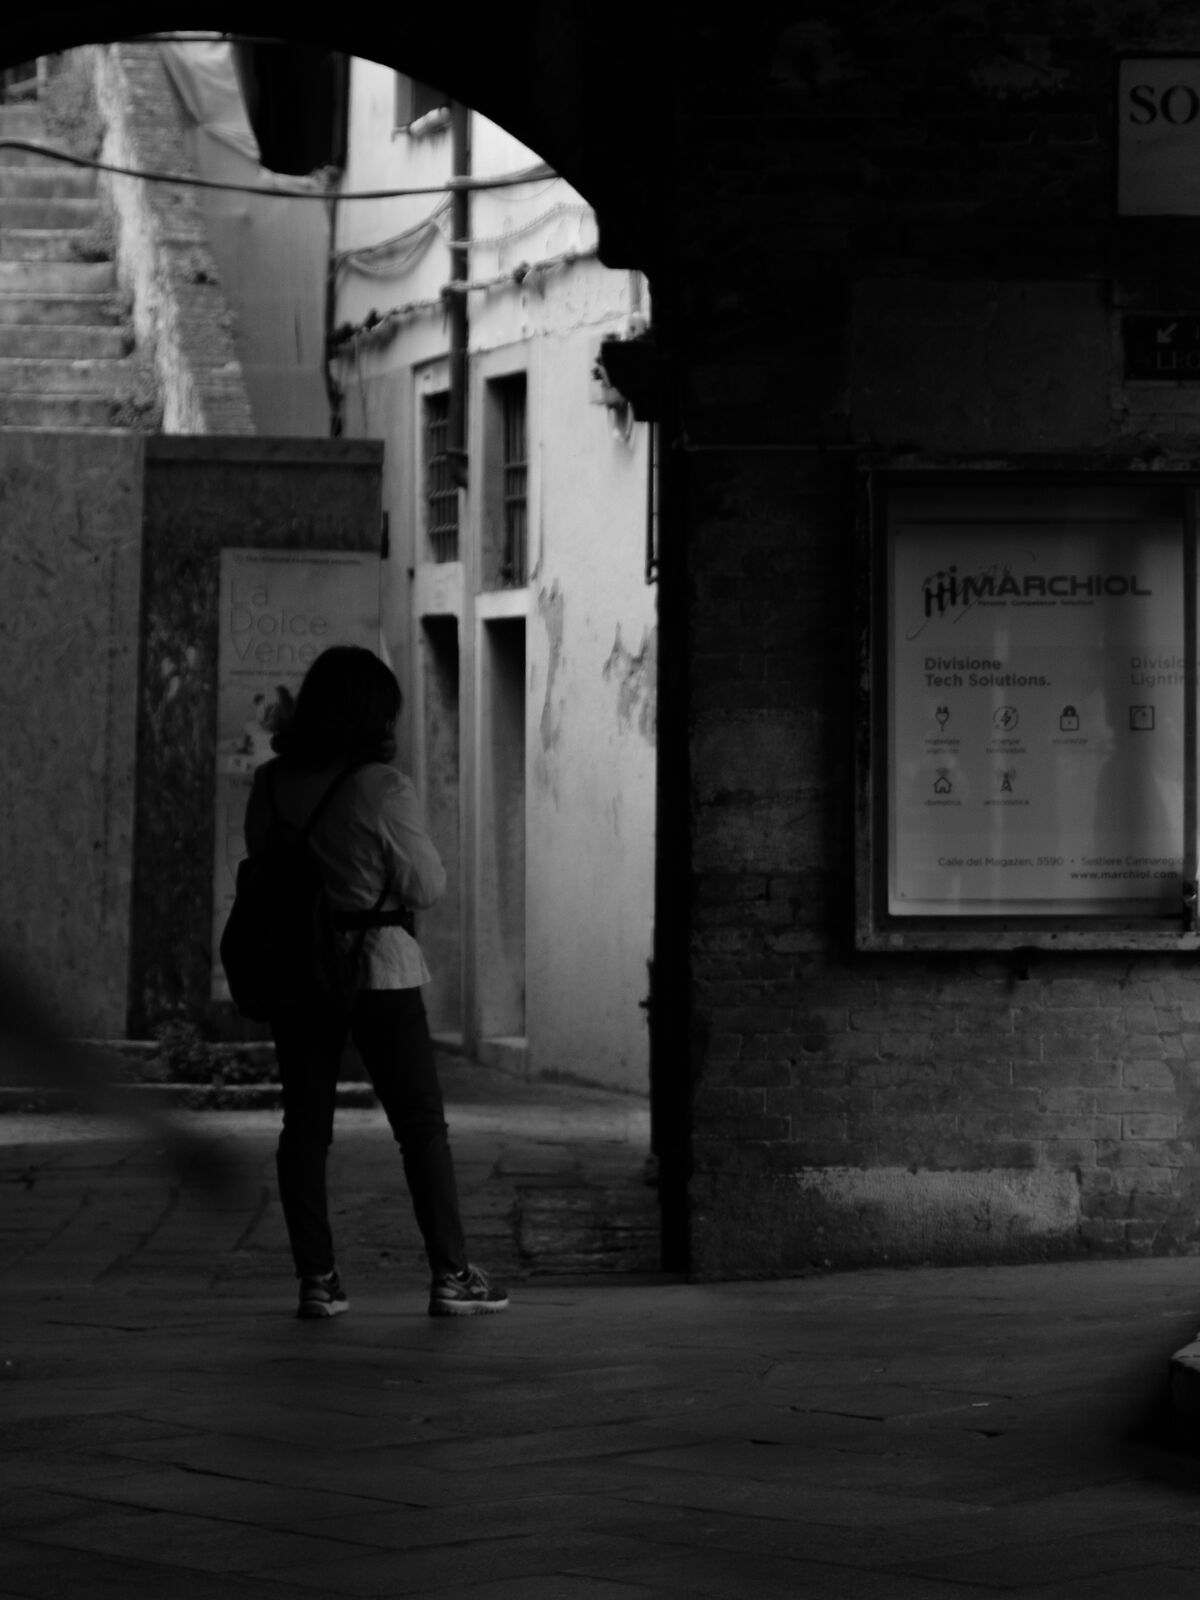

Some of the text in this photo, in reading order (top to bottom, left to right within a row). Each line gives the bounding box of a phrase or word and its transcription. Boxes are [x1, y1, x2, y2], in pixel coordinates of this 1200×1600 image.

[962, 575, 1151, 605] MARCHIOL
[230, 607, 328, 636] Dolce
[230, 635, 318, 665] Vene
[924, 656, 1002, 670] Divisione
[924, 673, 1051, 687] Tech Solutions.
[938, 855, 964, 866] Calle
[1070, 869, 1178, 880] www.marchiol.com
